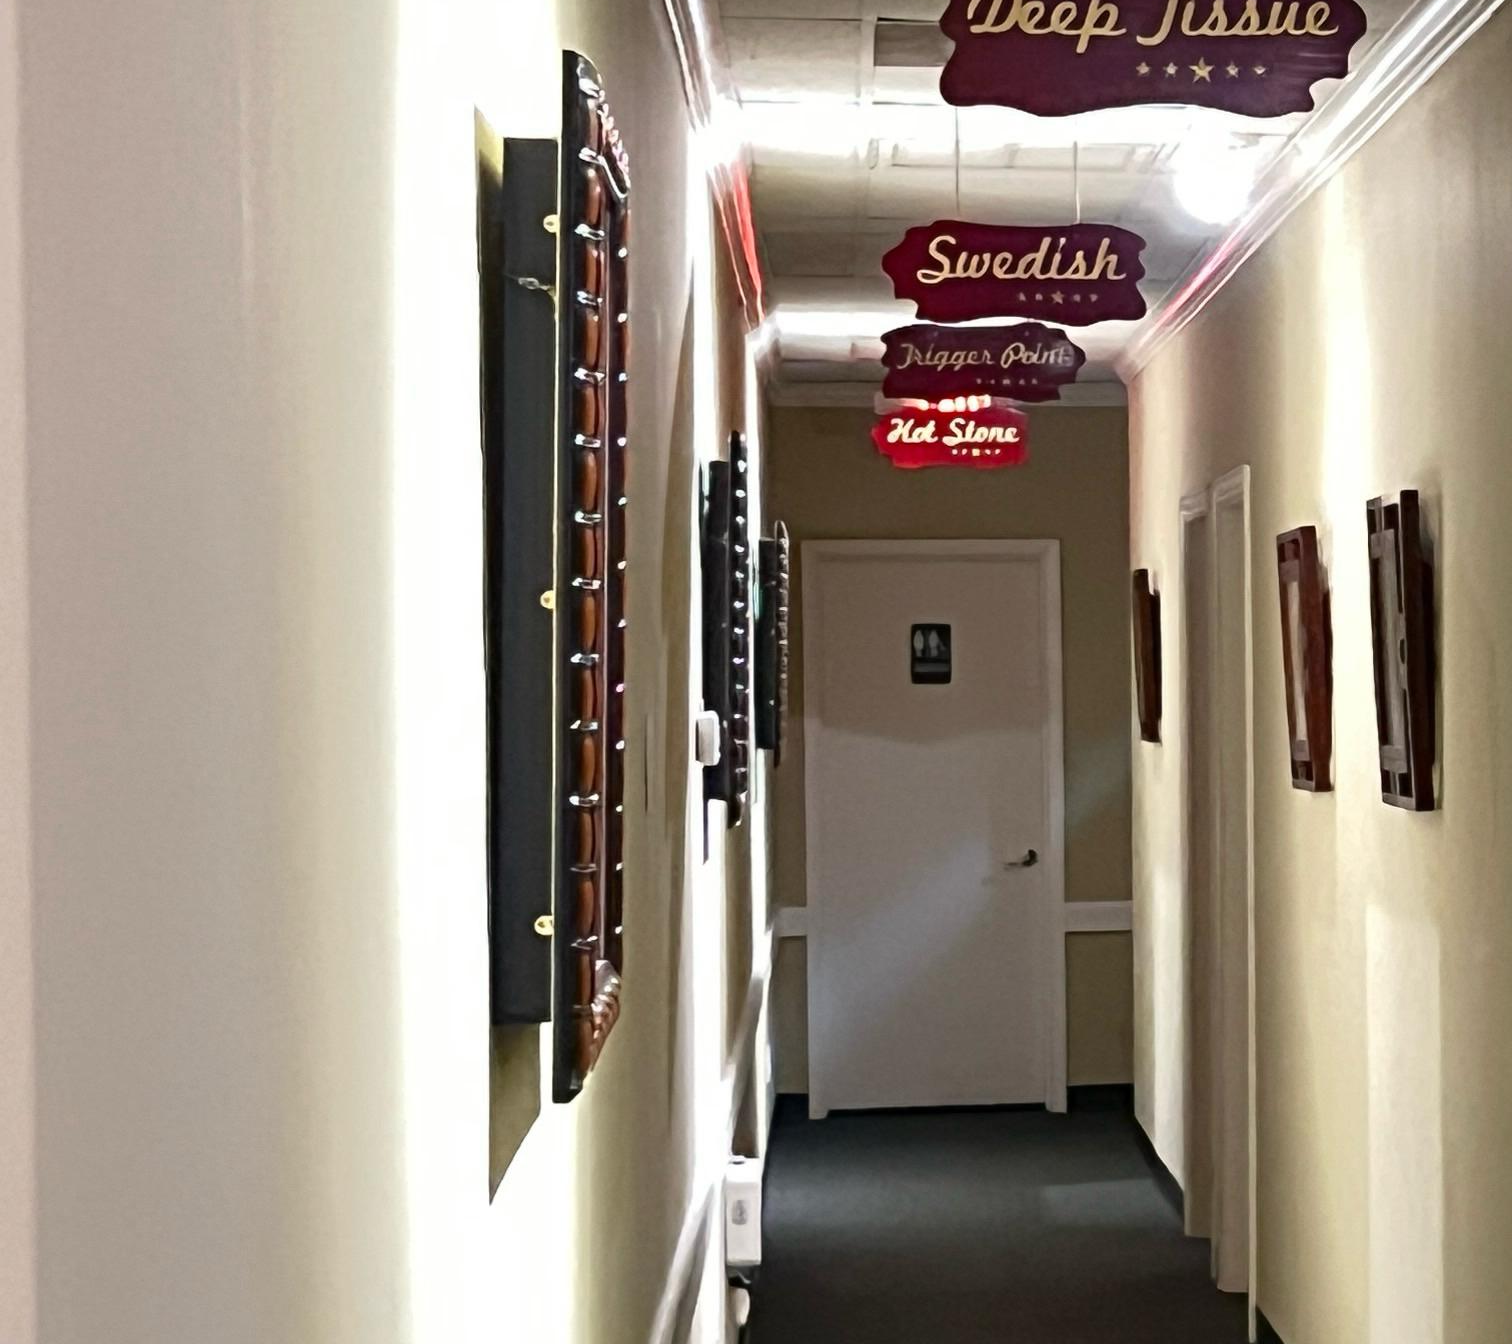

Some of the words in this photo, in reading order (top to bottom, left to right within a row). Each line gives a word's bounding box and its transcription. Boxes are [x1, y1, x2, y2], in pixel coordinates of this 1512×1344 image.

[915, 235, 1127, 285] Swedish
[896, 342, 996, 372] Trigger
[1000, 341, 1074, 369] Point
[886, 417, 939, 444] Hot
[942, 417, 1021, 447] Stone
